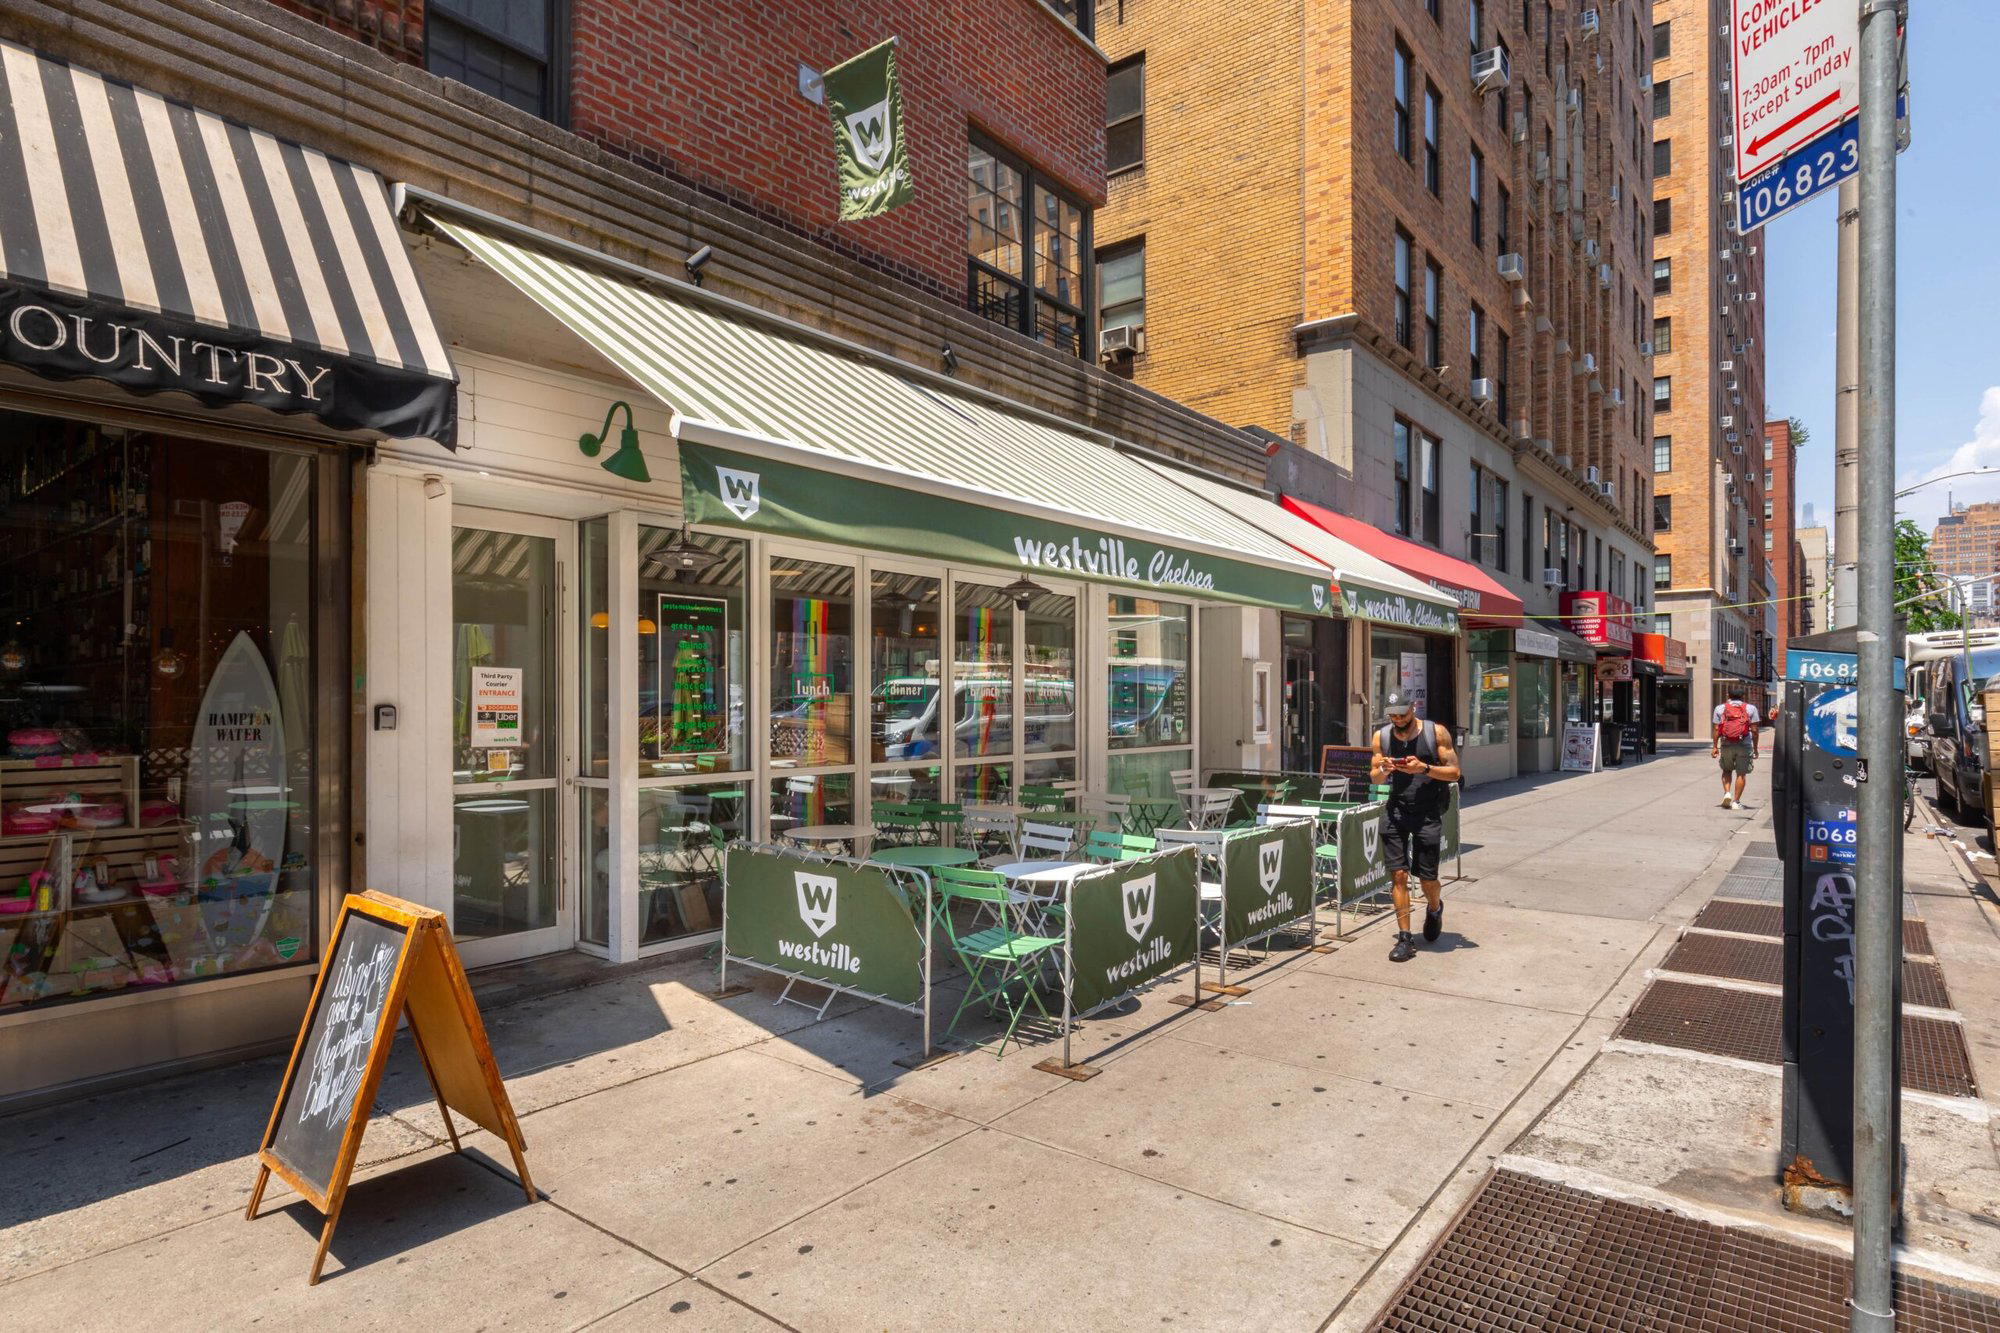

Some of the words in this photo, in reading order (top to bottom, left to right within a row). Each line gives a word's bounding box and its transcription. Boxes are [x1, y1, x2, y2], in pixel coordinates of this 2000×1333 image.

[1741, 0, 1821, 57] VEHICLE
[1742, 65, 1790, 108] 7:30am
[1803, 34, 1835, 67] 7pm
[1743, 89, 1794, 130] Except
[1795, 46, 1852, 96] Sunday
[1743, 139, 1858, 224] 106823
[1014, 536, 1140, 581] westville
[1148, 550, 1214, 591] Chelsea
[670, 623, 693, 632] green
[1364, 597, 1413, 625] westville
[1413, 603, 1443, 628] Chelsea
[797, 680, 830, 696] lunch
[890, 683, 922, 696] dinner
[217, 728, 263, 741] WATER
[1354, 861, 1386, 889] westville
[802, 882, 832, 913] W
[1127, 885, 1151, 919] W
[1248, 891, 1293, 926] westville
[779, 940, 860, 973] westville
[1106, 936, 1172, 984] westville
